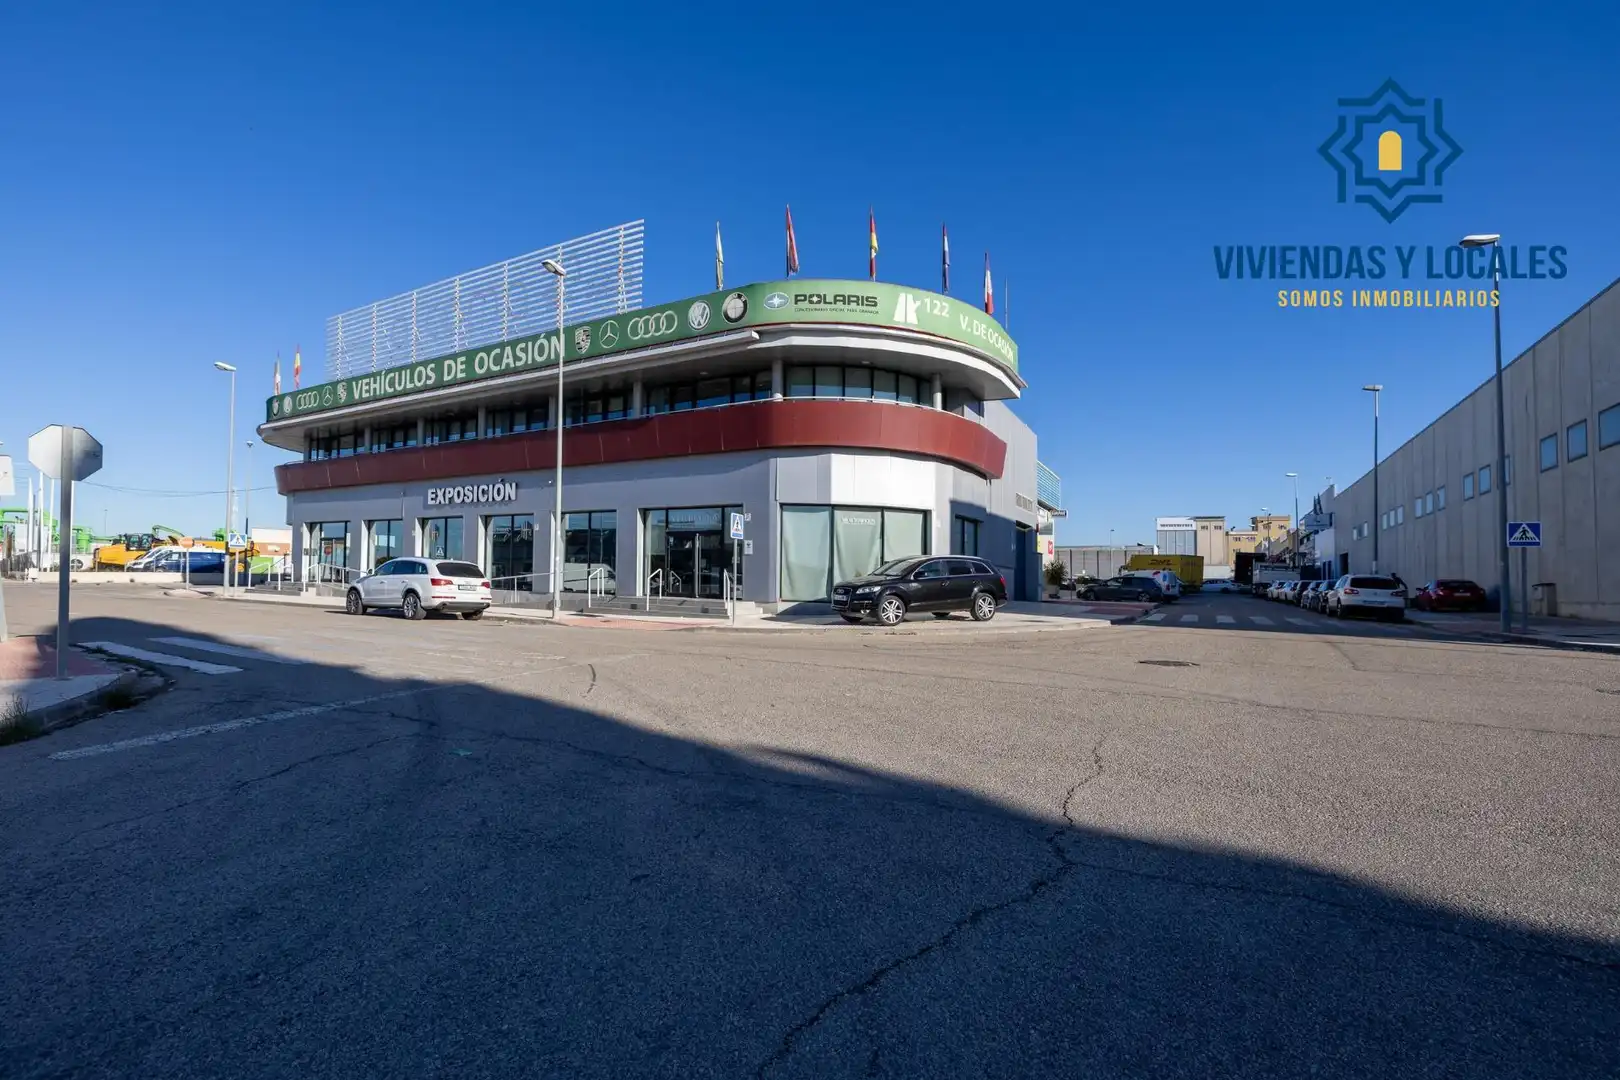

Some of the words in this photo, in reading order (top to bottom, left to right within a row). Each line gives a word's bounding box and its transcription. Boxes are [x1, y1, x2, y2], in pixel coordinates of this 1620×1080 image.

[794, 293, 878, 307] POLARIS
[923, 297, 950, 318] 122
[973, 319, 987, 340] DE
[352, 362, 436, 400] VEHÍCULOS
[443, 356, 466, 382] DE
[474, 333, 566, 375] OCASIÓN
[427, 478, 517, 505] EXPOSICIÓN
